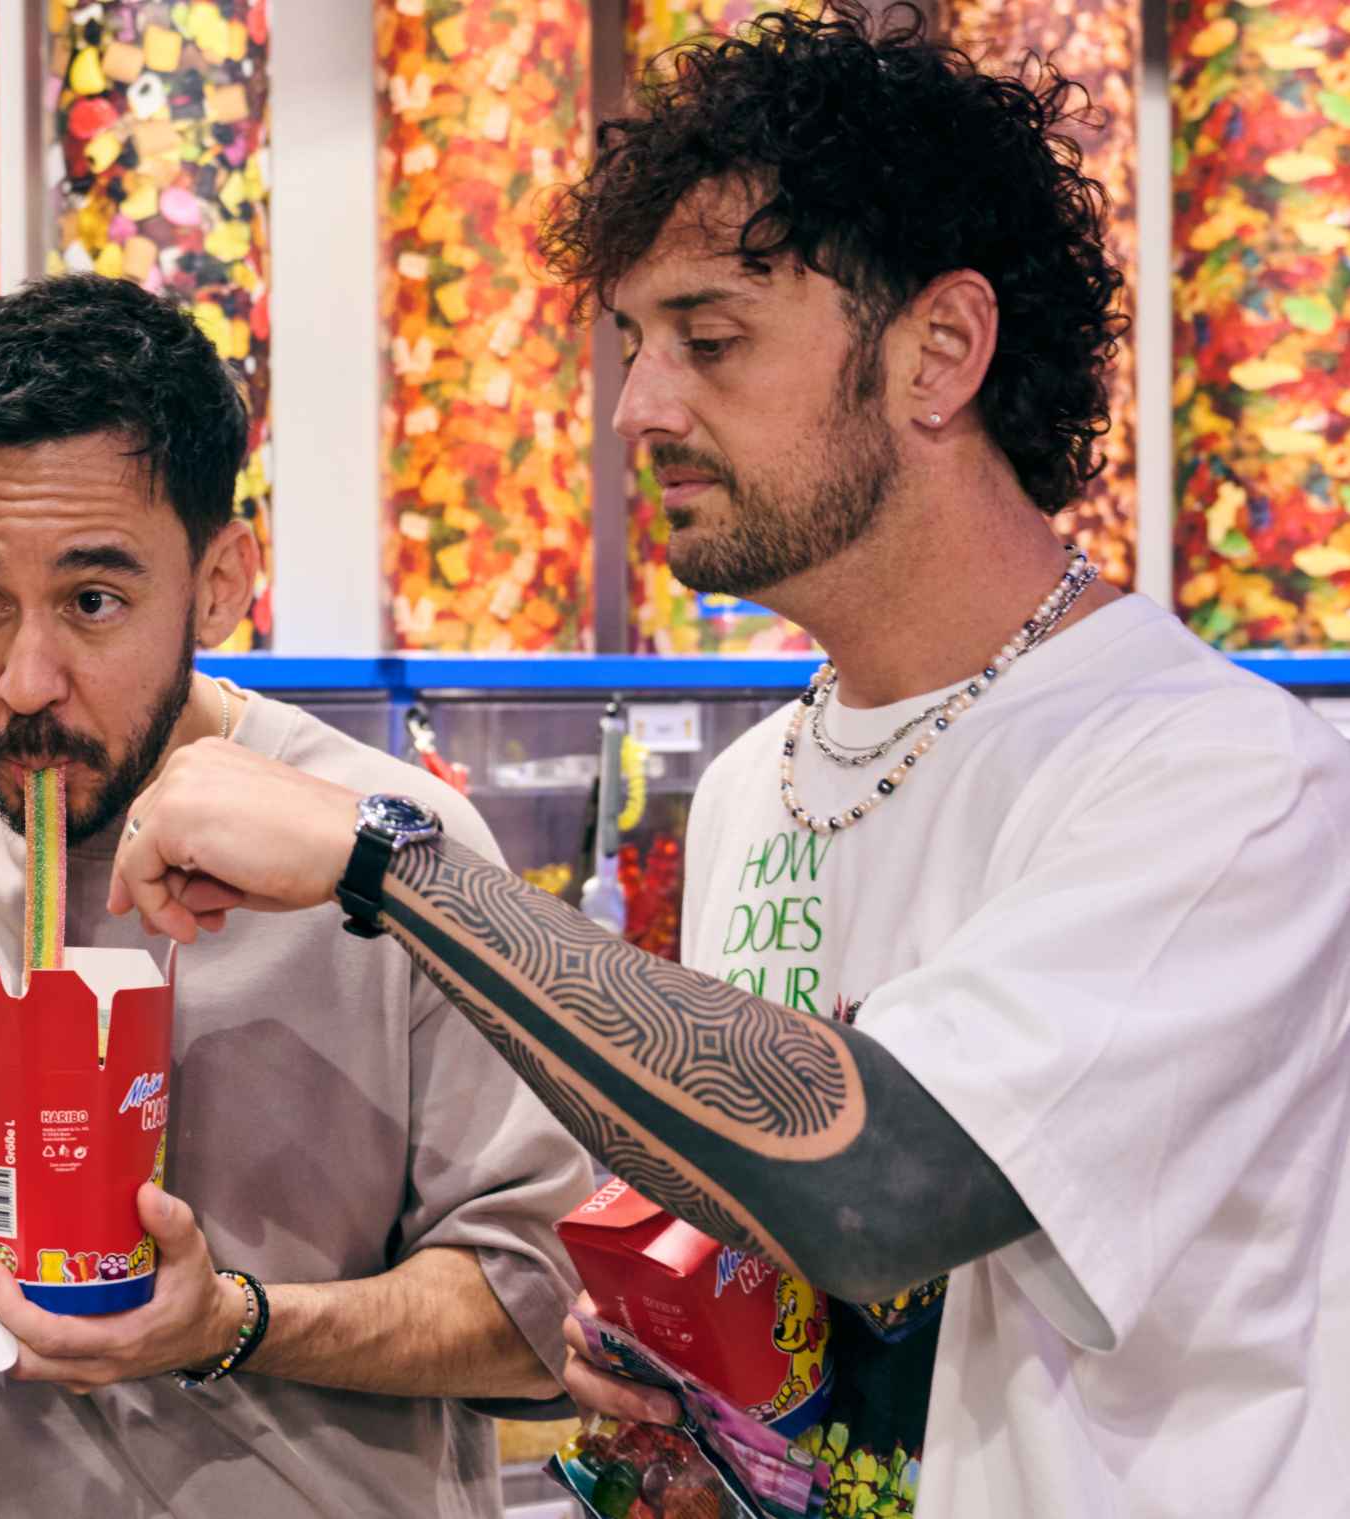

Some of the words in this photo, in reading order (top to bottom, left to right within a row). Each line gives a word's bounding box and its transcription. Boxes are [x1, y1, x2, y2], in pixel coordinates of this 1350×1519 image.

[738, 830, 835, 892] HOW
[722, 896, 822, 955] DOES
[716, 966, 819, 1014] OUR
[40, 1109, 89, 1124] HARIBO
